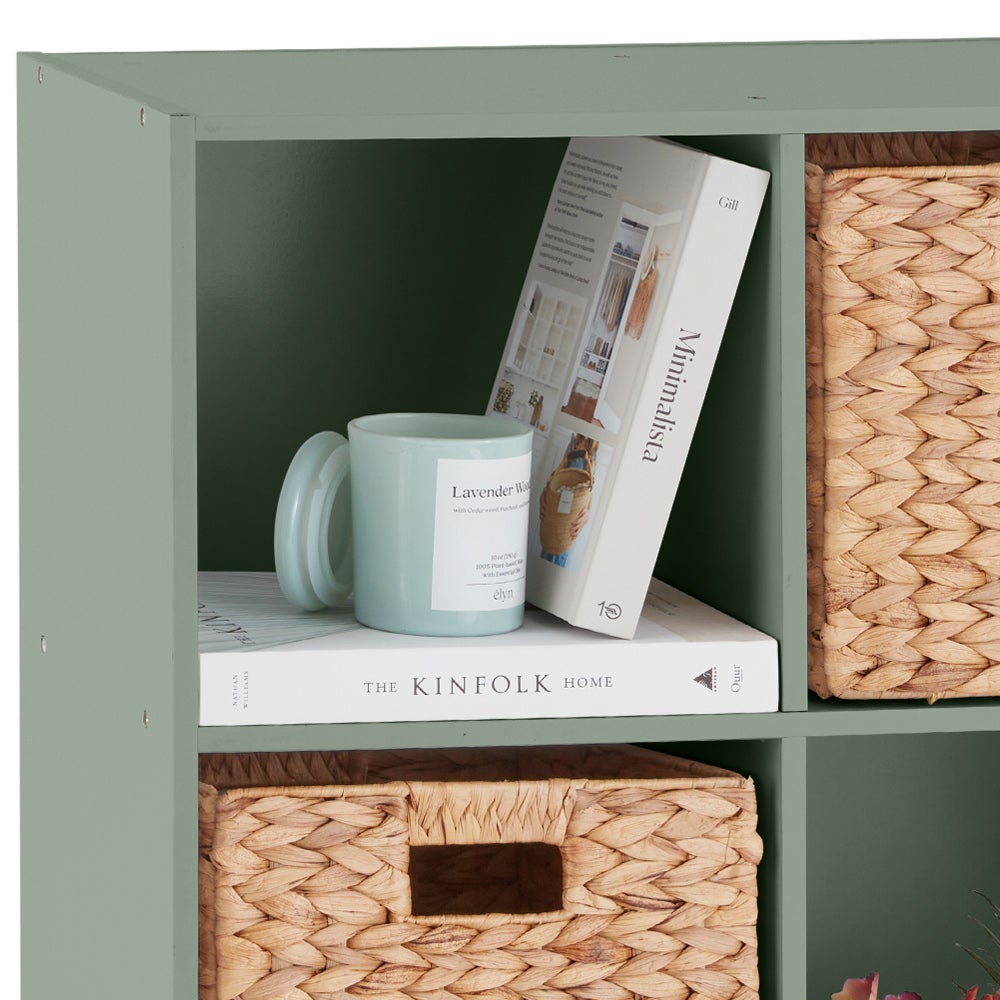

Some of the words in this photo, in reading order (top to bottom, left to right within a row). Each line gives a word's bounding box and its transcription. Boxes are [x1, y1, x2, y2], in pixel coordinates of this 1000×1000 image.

[718, 196, 740, 212] Gill
[641, 328, 702, 462] Minimalista
[452, 485, 514, 498] Lavender
[363, 681, 398, 694] THE
[412, 674, 552, 696] KINFOLK
[563, 676, 614, 689] HOME
